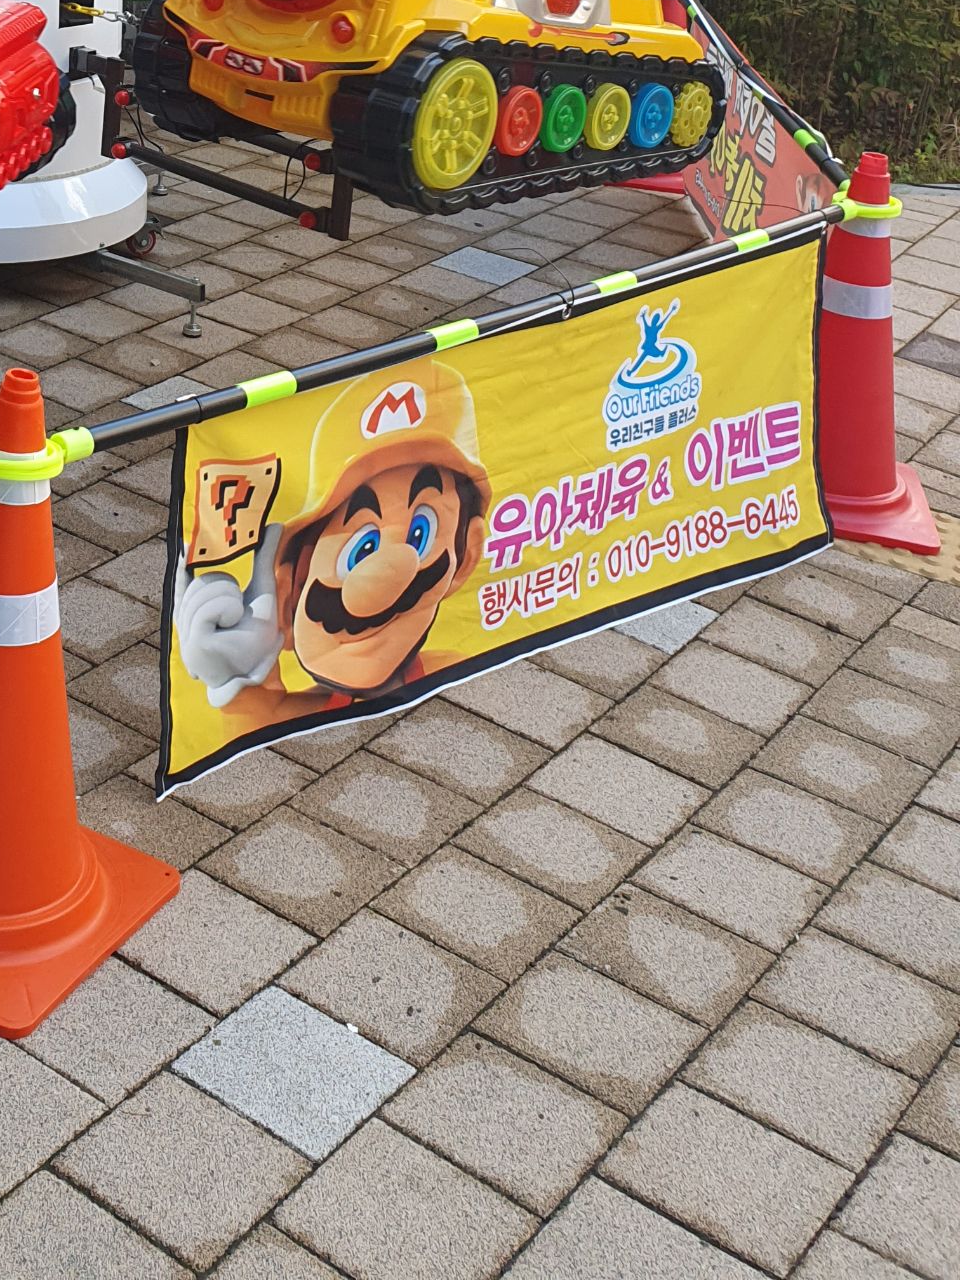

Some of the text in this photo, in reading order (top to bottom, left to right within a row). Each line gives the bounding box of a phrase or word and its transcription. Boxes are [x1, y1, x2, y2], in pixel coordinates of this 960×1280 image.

[366, 386, 422, 434] M
[606, 375, 700, 422] Our Friends
[610, 405, 697, 447] 우리친구들 플러스
[488, 406, 800, 569] 유아체육 & 이벤트
[481, 557, 580, 627] 행사문의
[607, 489, 798, 578] 010-9188-6445
